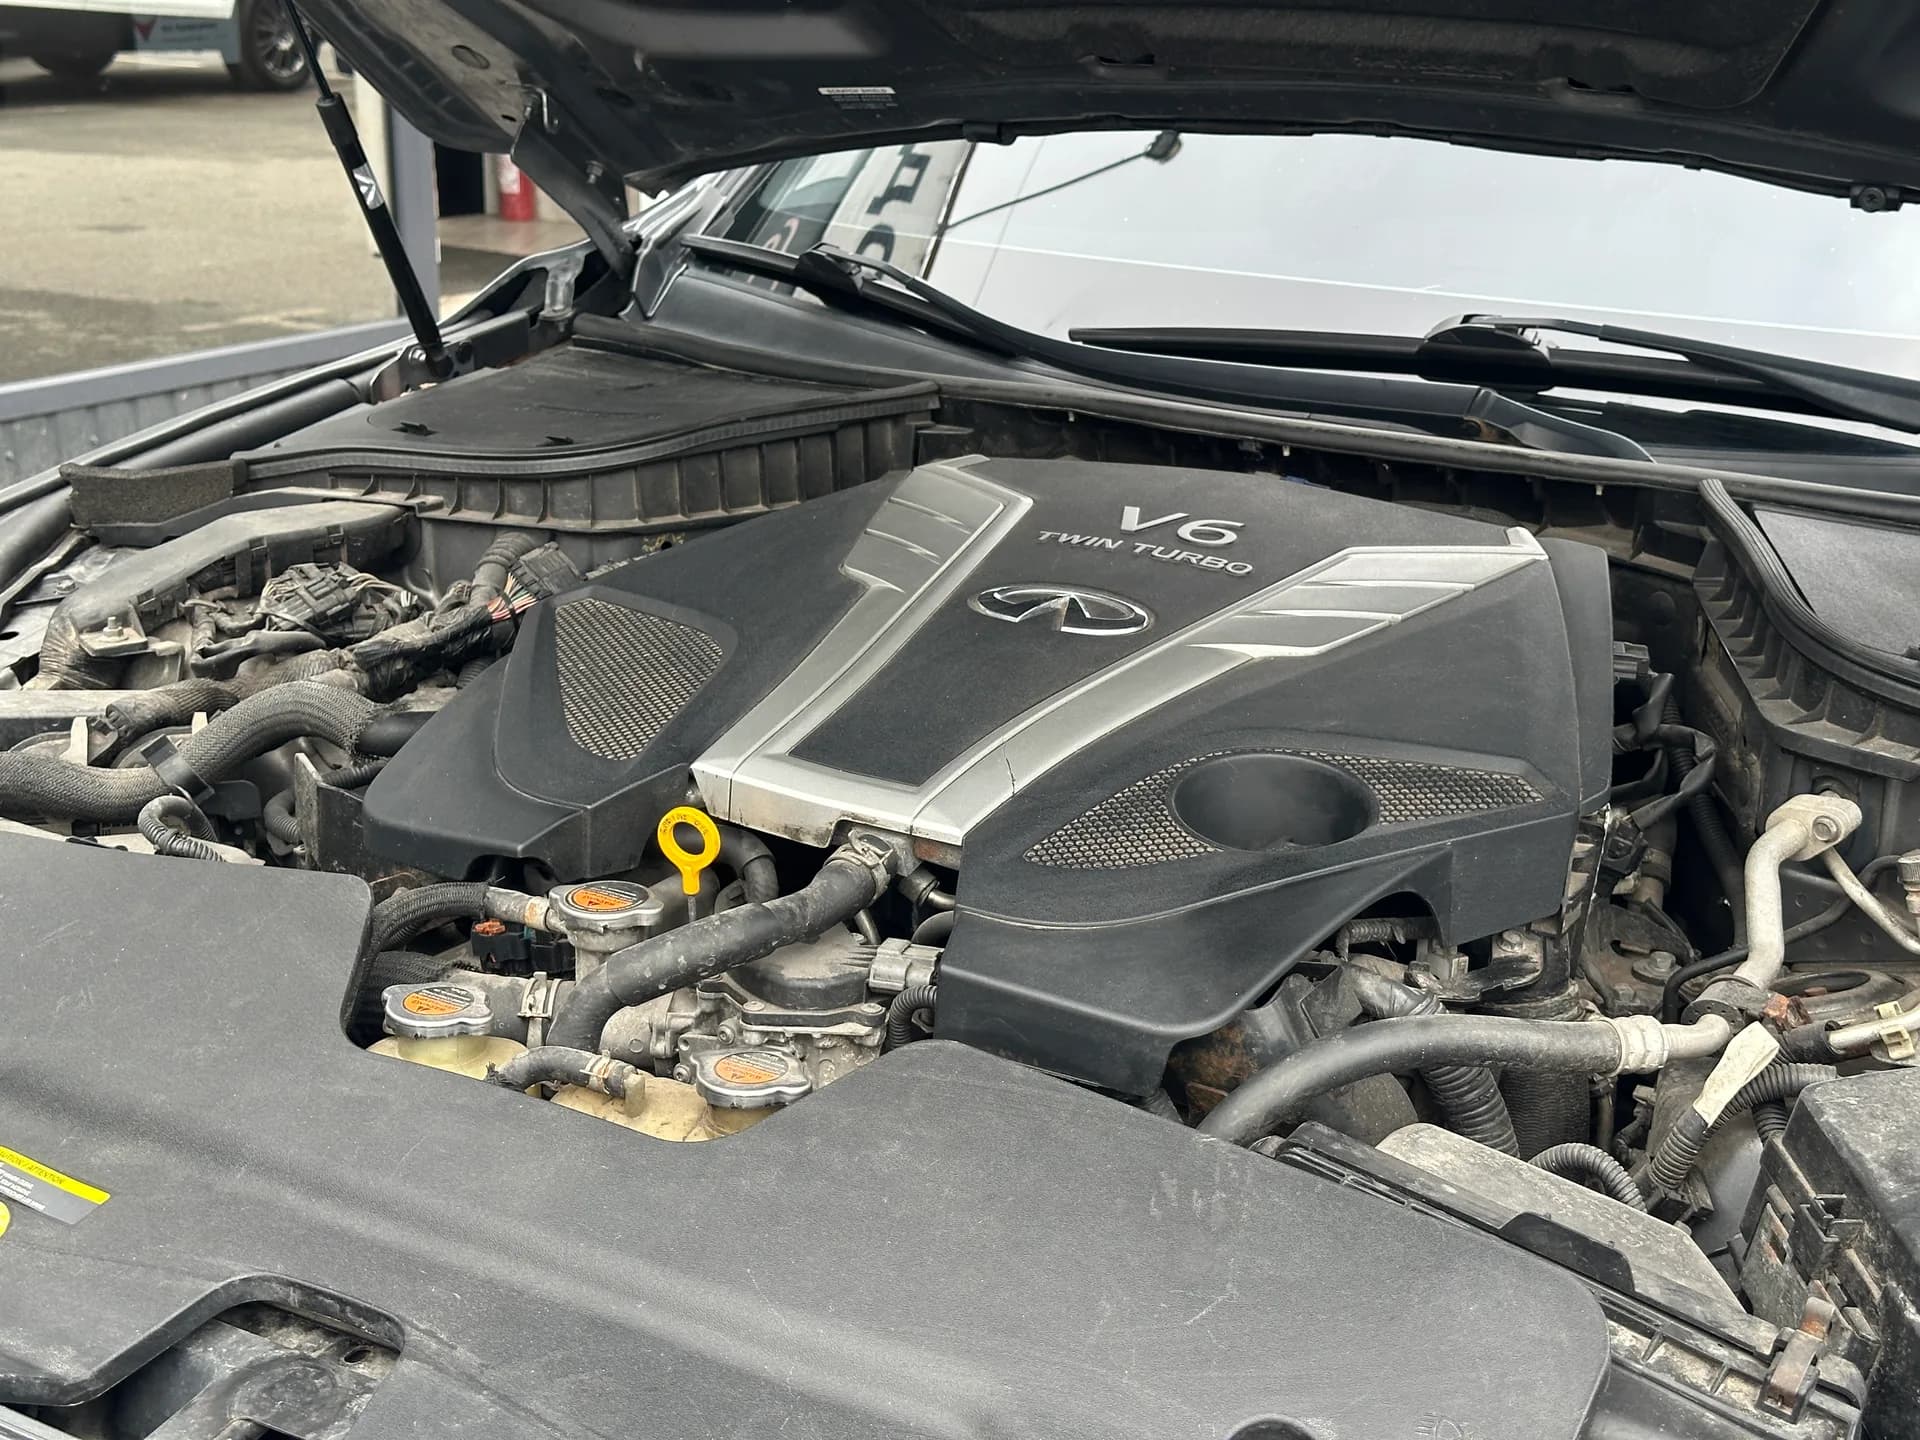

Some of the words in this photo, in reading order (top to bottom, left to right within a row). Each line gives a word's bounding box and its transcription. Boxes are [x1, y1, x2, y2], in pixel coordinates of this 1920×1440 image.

[1120, 505, 1246, 546] V6
[1037, 530, 1124, 551] TWIN
[1132, 541, 1254, 576] TURBO
